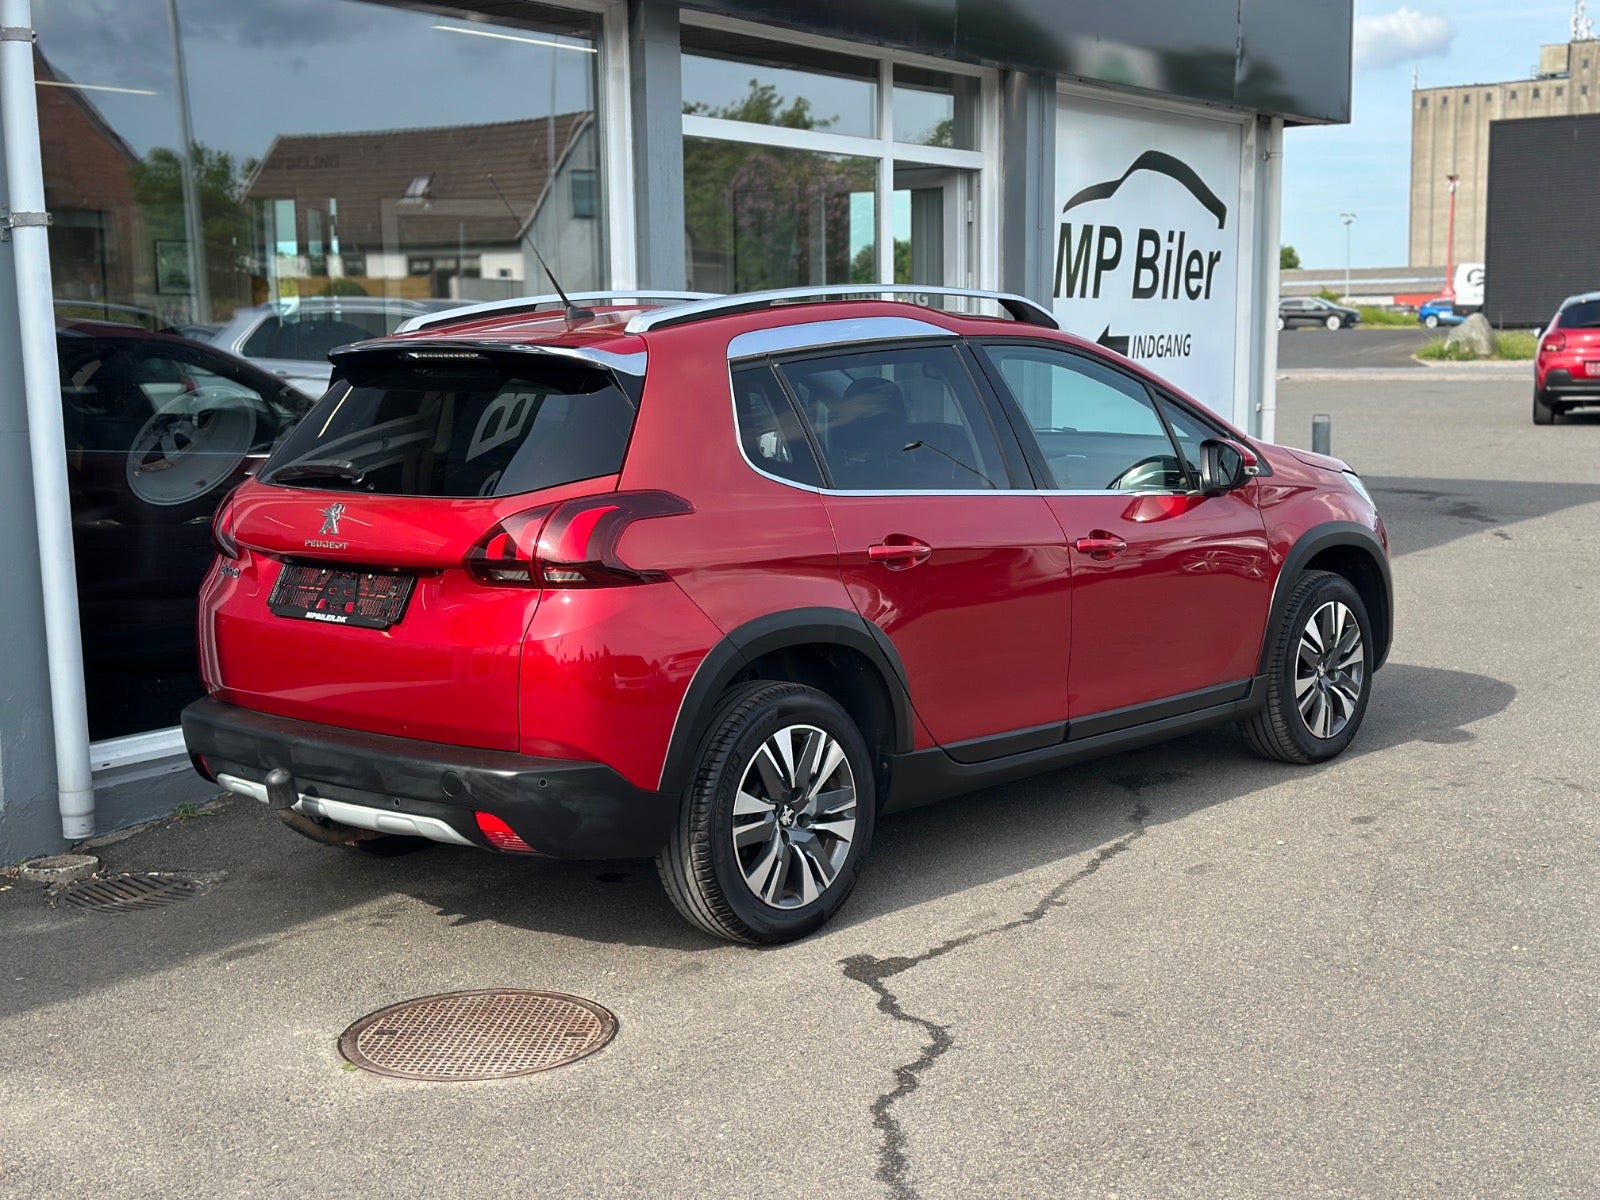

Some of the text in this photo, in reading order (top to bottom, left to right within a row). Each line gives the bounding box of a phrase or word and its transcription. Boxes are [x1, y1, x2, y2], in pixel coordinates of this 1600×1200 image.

[1053, 222, 1222, 301] MP Biler
[1131, 333, 1192, 359] INDGANG
[304, 540, 349, 549] PEUGEOT
